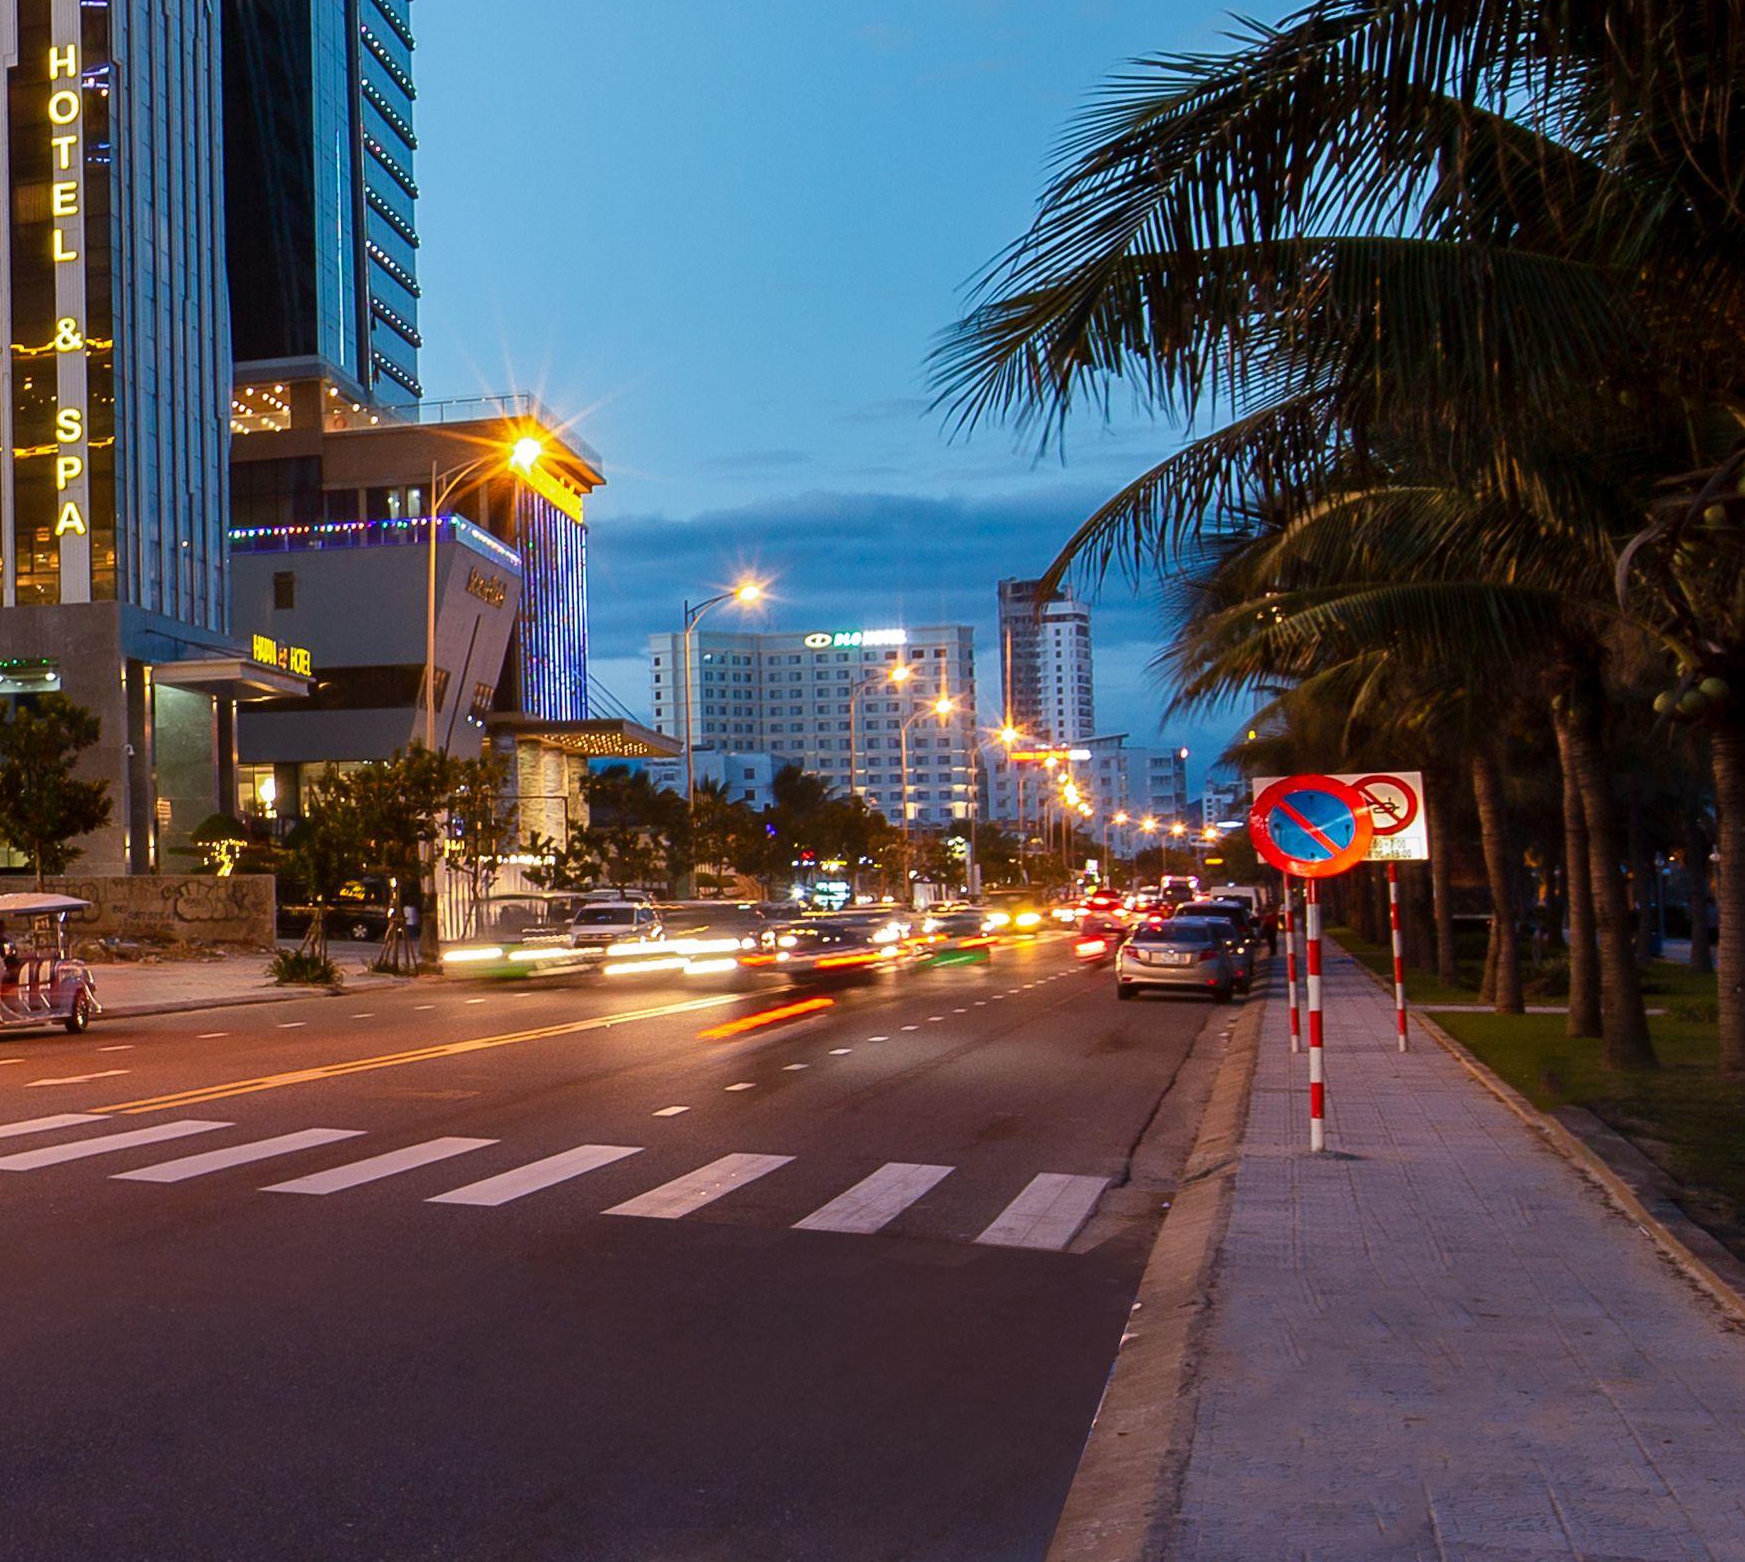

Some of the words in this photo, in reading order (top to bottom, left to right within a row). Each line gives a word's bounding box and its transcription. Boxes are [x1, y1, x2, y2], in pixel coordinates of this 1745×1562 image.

[48, 45, 80, 262] HOTEL
[54, 316, 83, 353] &
[55, 407, 86, 536] SPA
